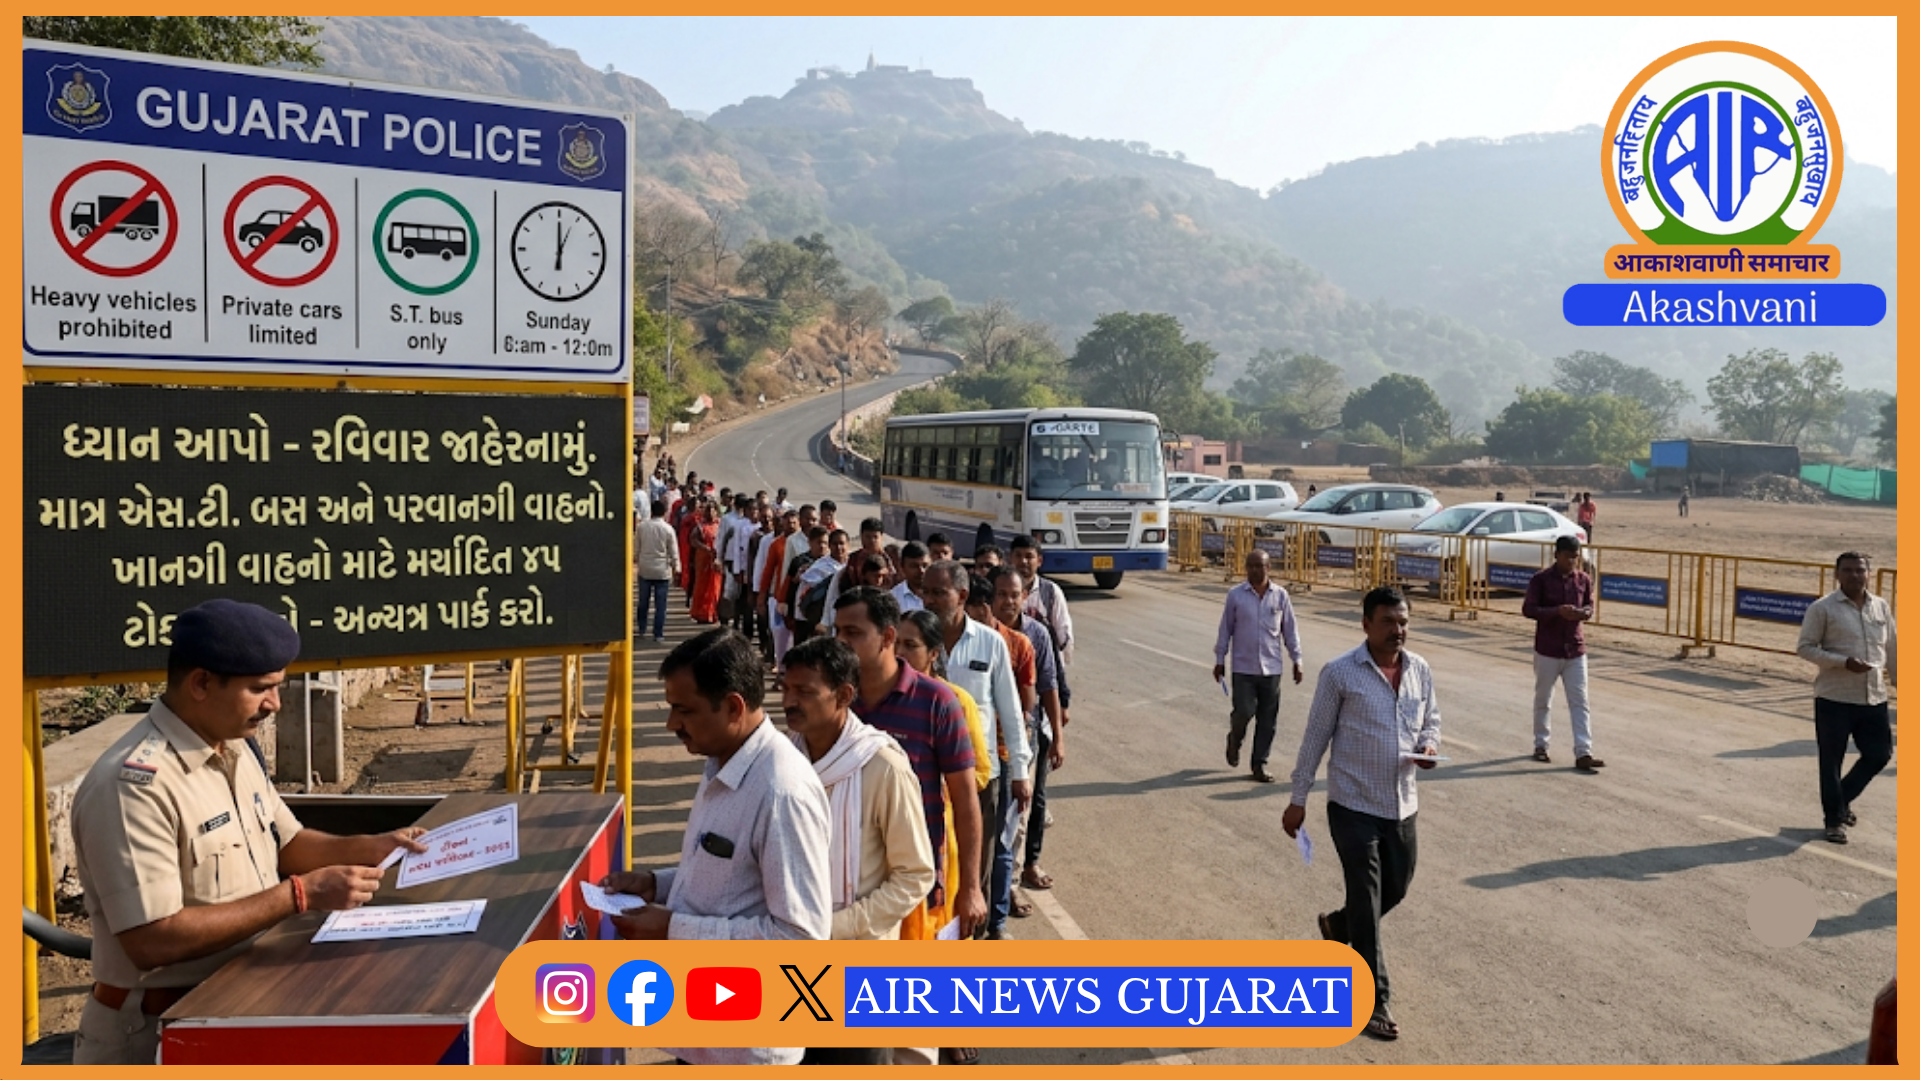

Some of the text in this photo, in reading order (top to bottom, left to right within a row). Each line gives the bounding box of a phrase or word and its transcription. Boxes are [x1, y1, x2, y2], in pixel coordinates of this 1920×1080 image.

[136, 85, 543, 166] GUJARAT POLICE
[32, 286, 196, 313] Heavy vehicles
[223, 295, 342, 319] Private cars
[391, 304, 462, 325] S.T. bus
[527, 311, 589, 334] Sunday
[59, 318, 171, 340] prohibited
[250, 324, 316, 344] limited
[408, 333, 446, 354] only
[64, 424, 159, 461] ધ્યાન
[175, 413, 269, 461] આપો
[312, 415, 429, 462] રવિવાર
[442, 416, 595, 476] જાહેરનામું.
[39, 481, 613, 529] માત્ર એસ.ટી. બસ અને પરવાનગી વાહનો.
[112, 535, 560, 586] ખાનગી વાહનો માટે મર્યાદિત ૪૫
[334, 604, 429, 634] અન્યત્ર
[438, 587, 489, 628] પાર્ક
[500, 585, 552, 626] કરો.
